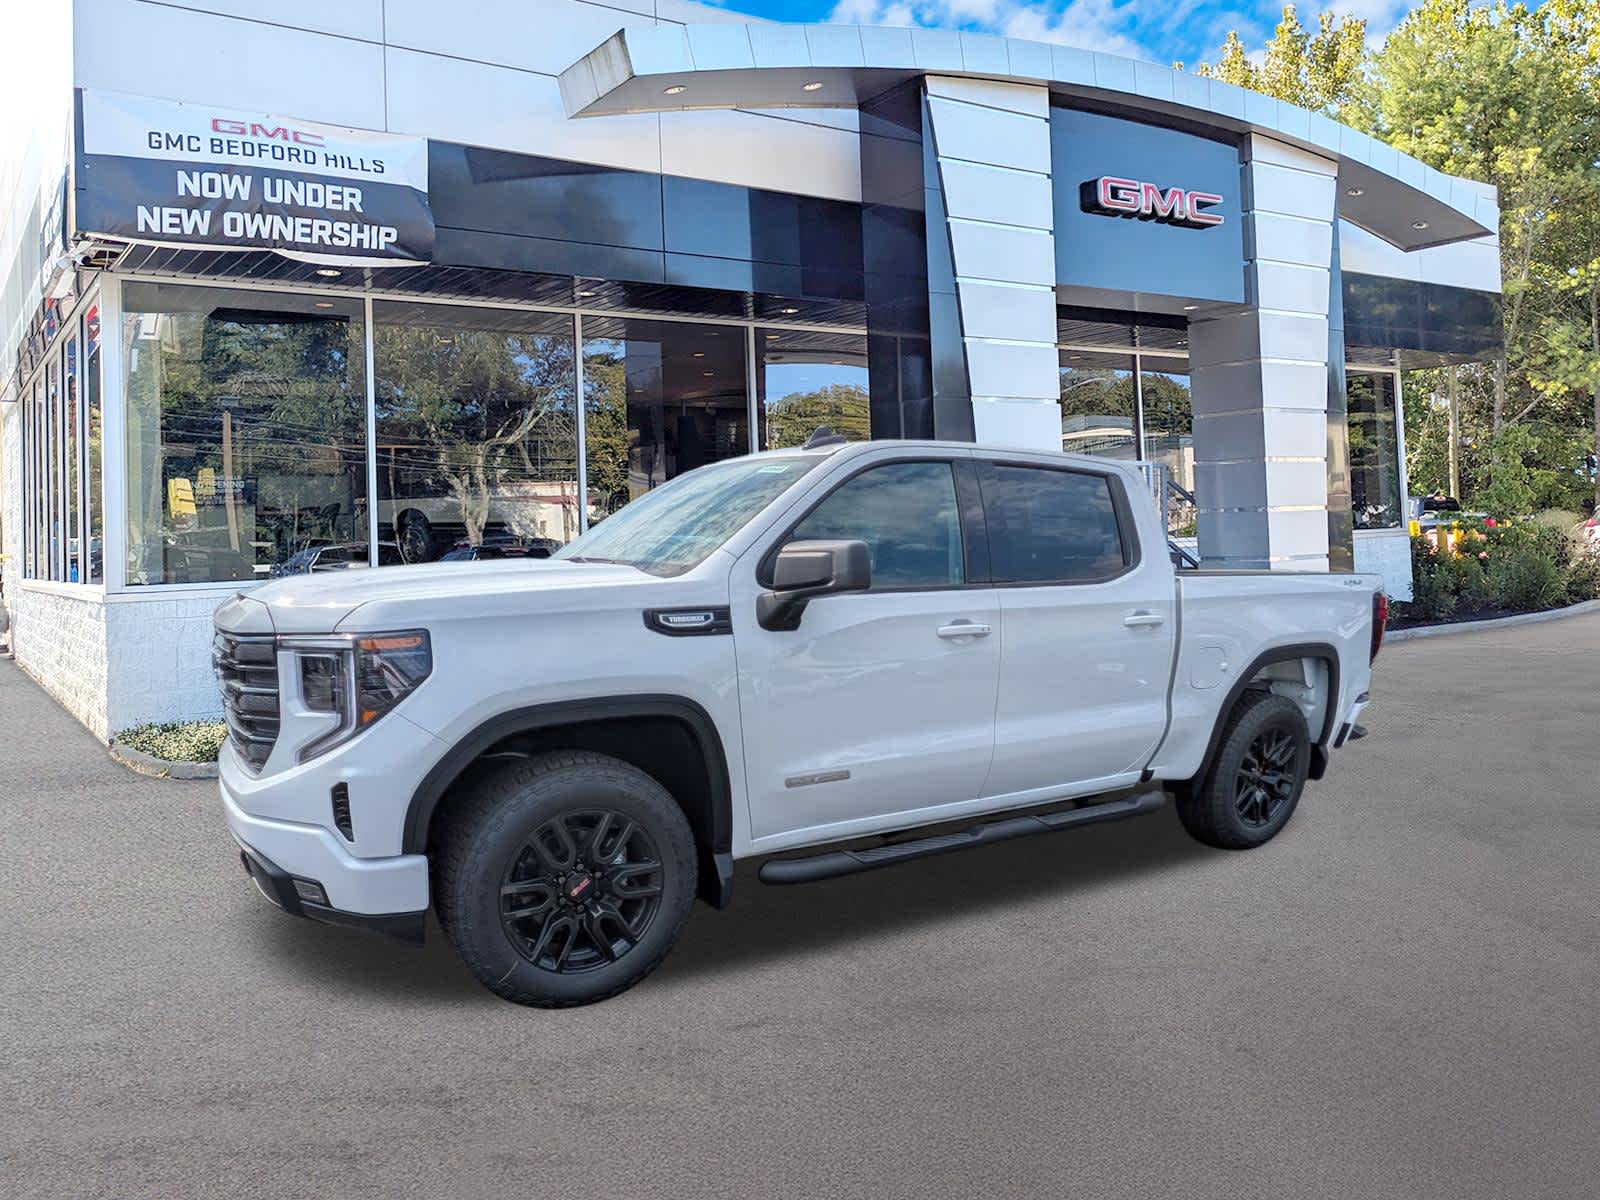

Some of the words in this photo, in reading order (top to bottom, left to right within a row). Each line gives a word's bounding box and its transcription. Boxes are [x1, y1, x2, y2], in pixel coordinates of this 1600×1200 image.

[148, 131, 201, 153] GMC
[210, 138, 317, 165] BEDFORD
[324, 152, 385, 174] HILLS
[211, 117, 326, 148] GMC
[176, 170, 252, 201] NOW
[263, 177, 364, 213] UNDER
[1096, 175, 1225, 225] GMC
[136, 205, 212, 236] NEW
[223, 210, 398, 250] OWNERSHIP
